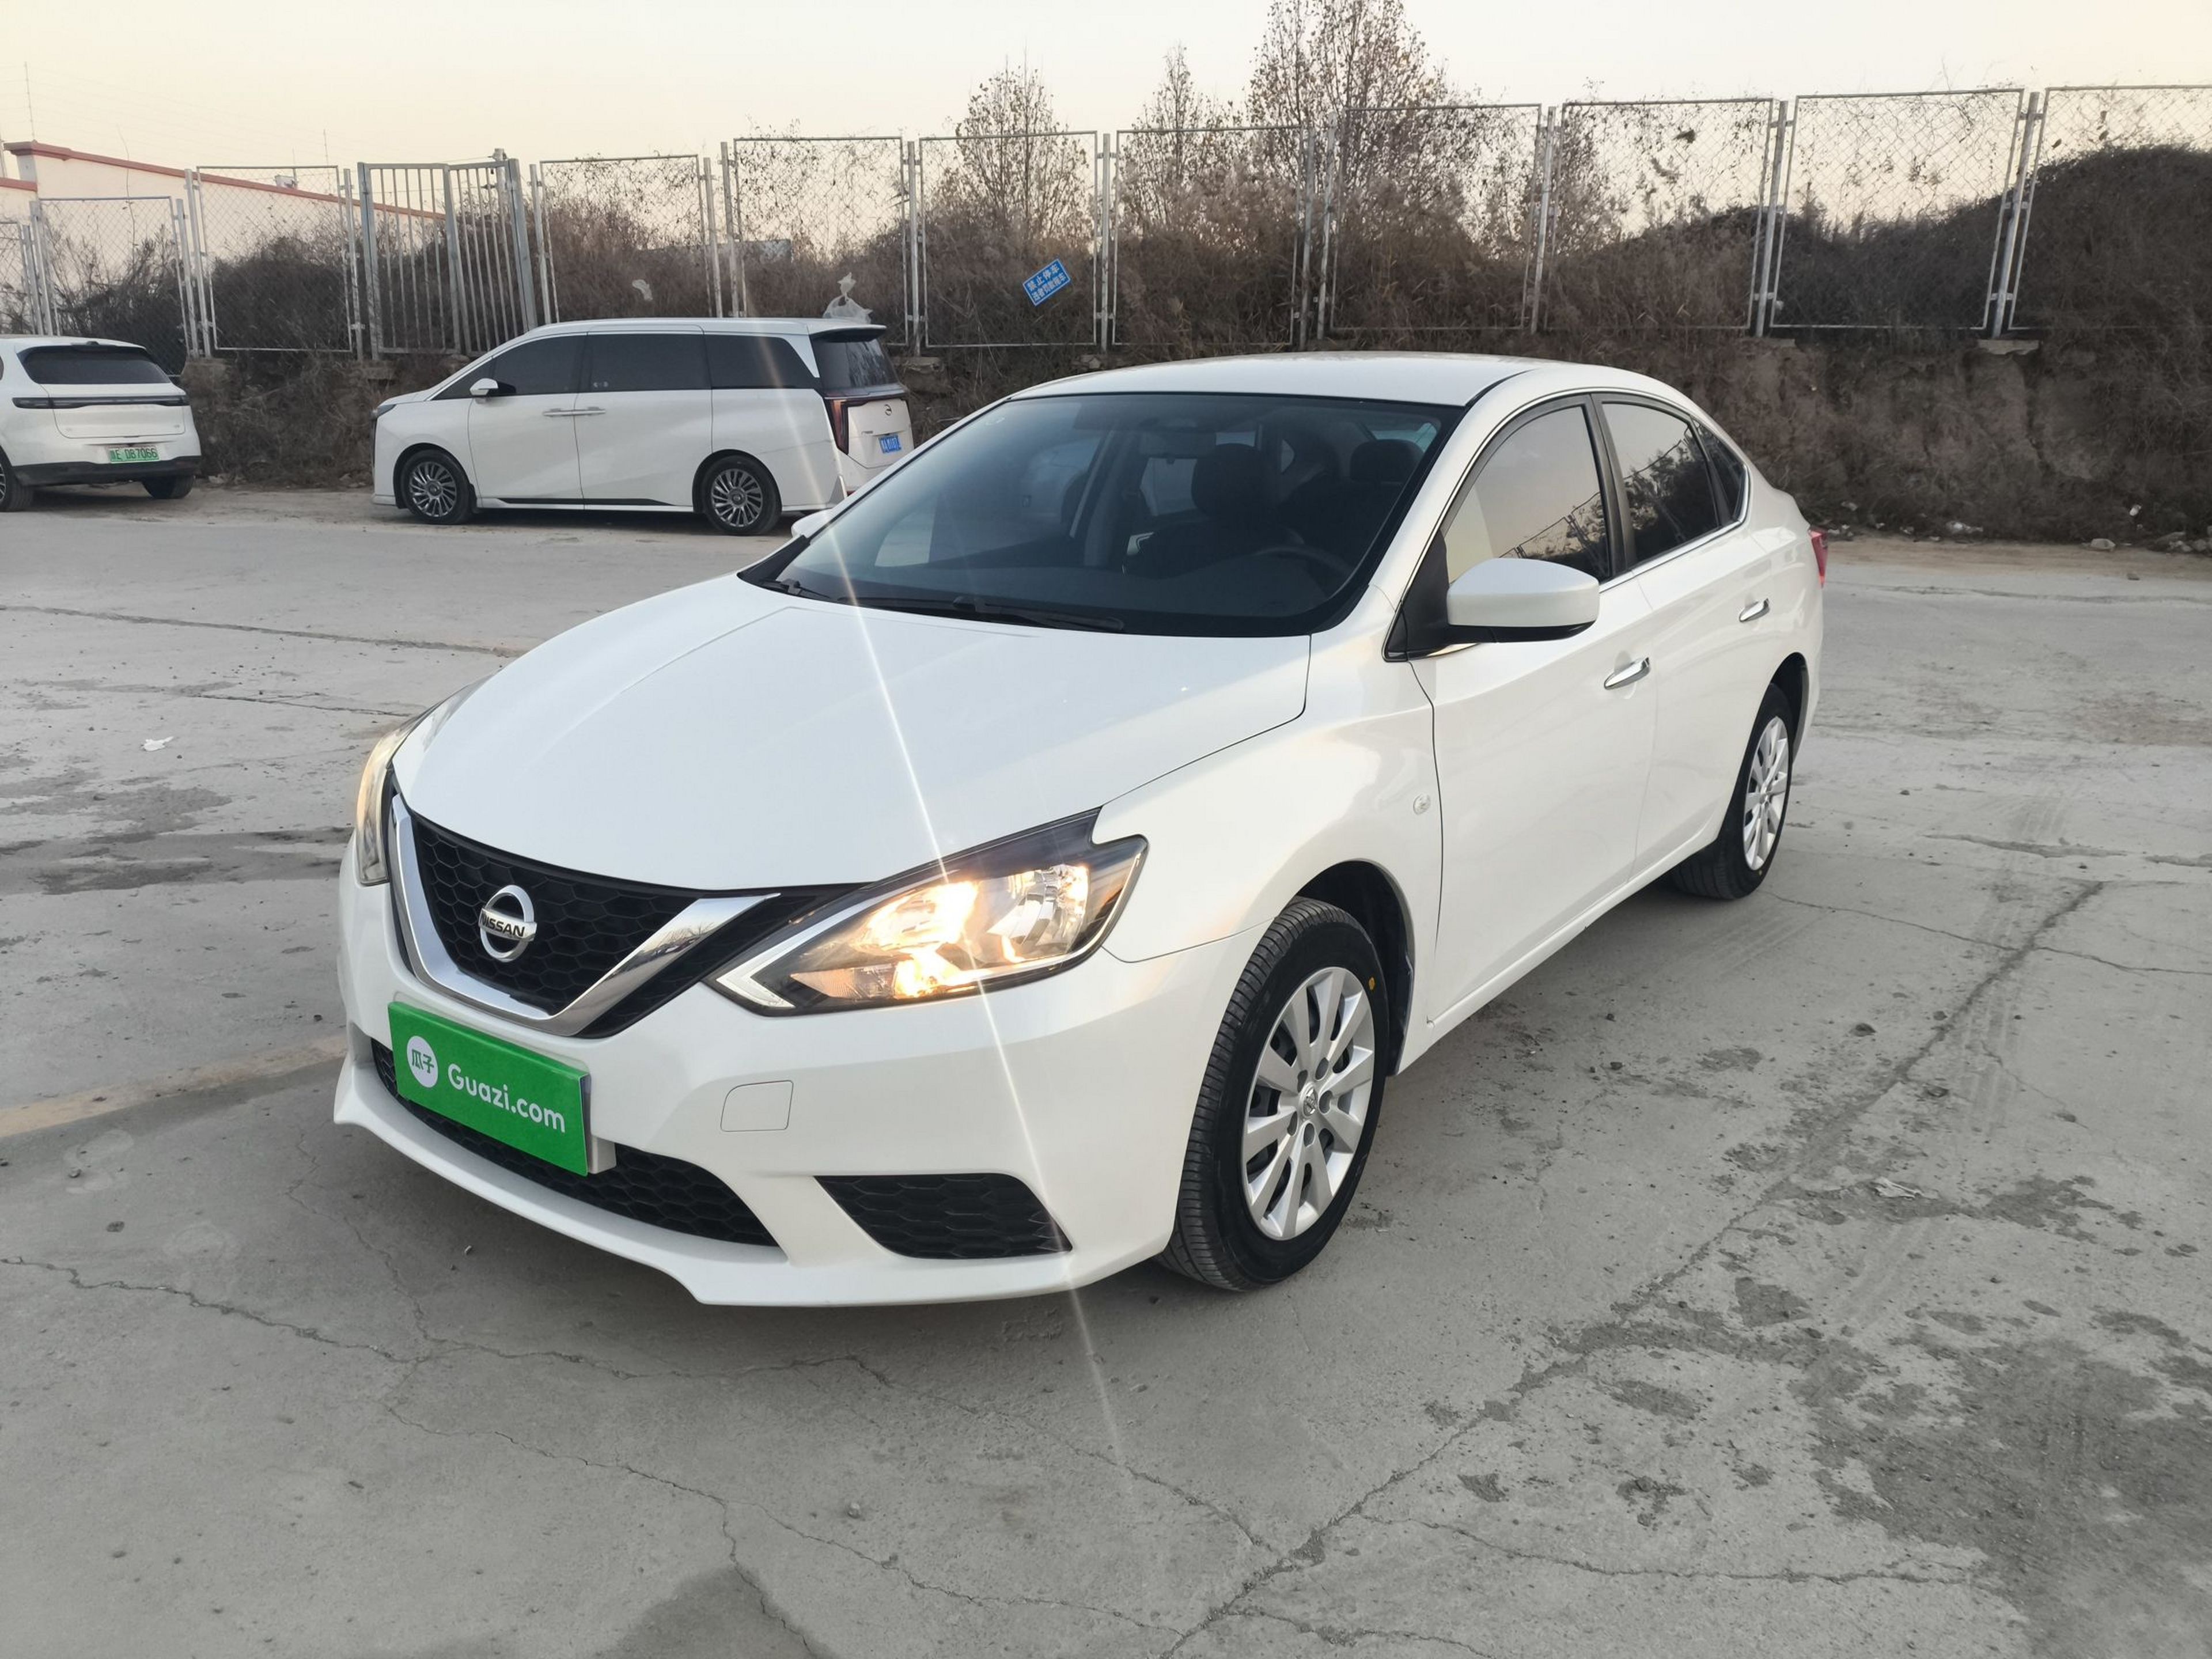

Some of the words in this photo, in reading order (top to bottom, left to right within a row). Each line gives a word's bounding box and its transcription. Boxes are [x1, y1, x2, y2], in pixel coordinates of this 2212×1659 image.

[480, 910, 525, 937] NISSAN
[412, 1048, 434, 1074] 瓜子
[448, 1063, 565, 1133] Guazi.com
